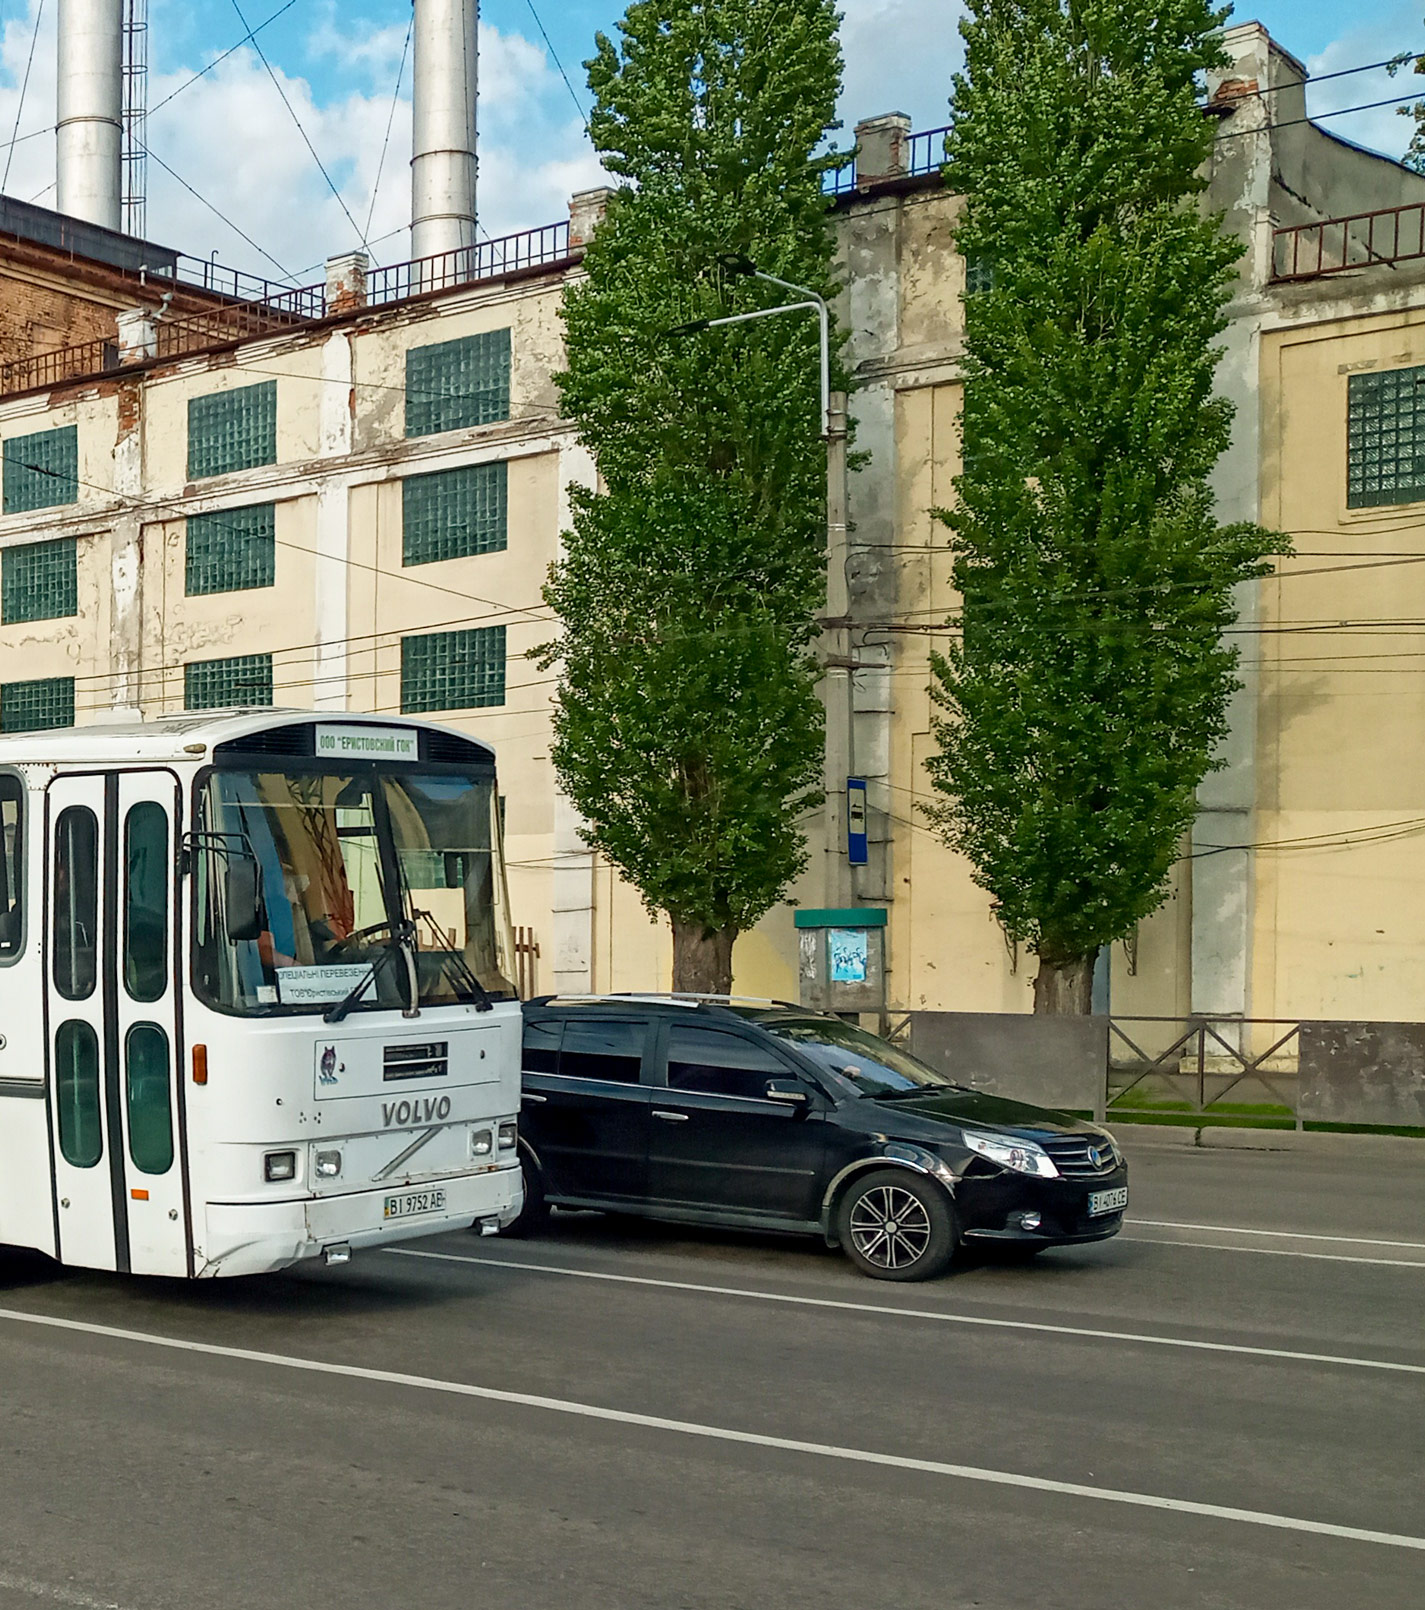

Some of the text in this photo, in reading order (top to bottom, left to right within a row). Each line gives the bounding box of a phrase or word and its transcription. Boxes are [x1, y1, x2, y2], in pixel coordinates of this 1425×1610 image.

[320, 735, 335, 749] ООО
[381, 1095, 451, 1127] VOLVO
[390, 1198, 402, 1215] BI
[406, 1194, 428, 1212] 9752
